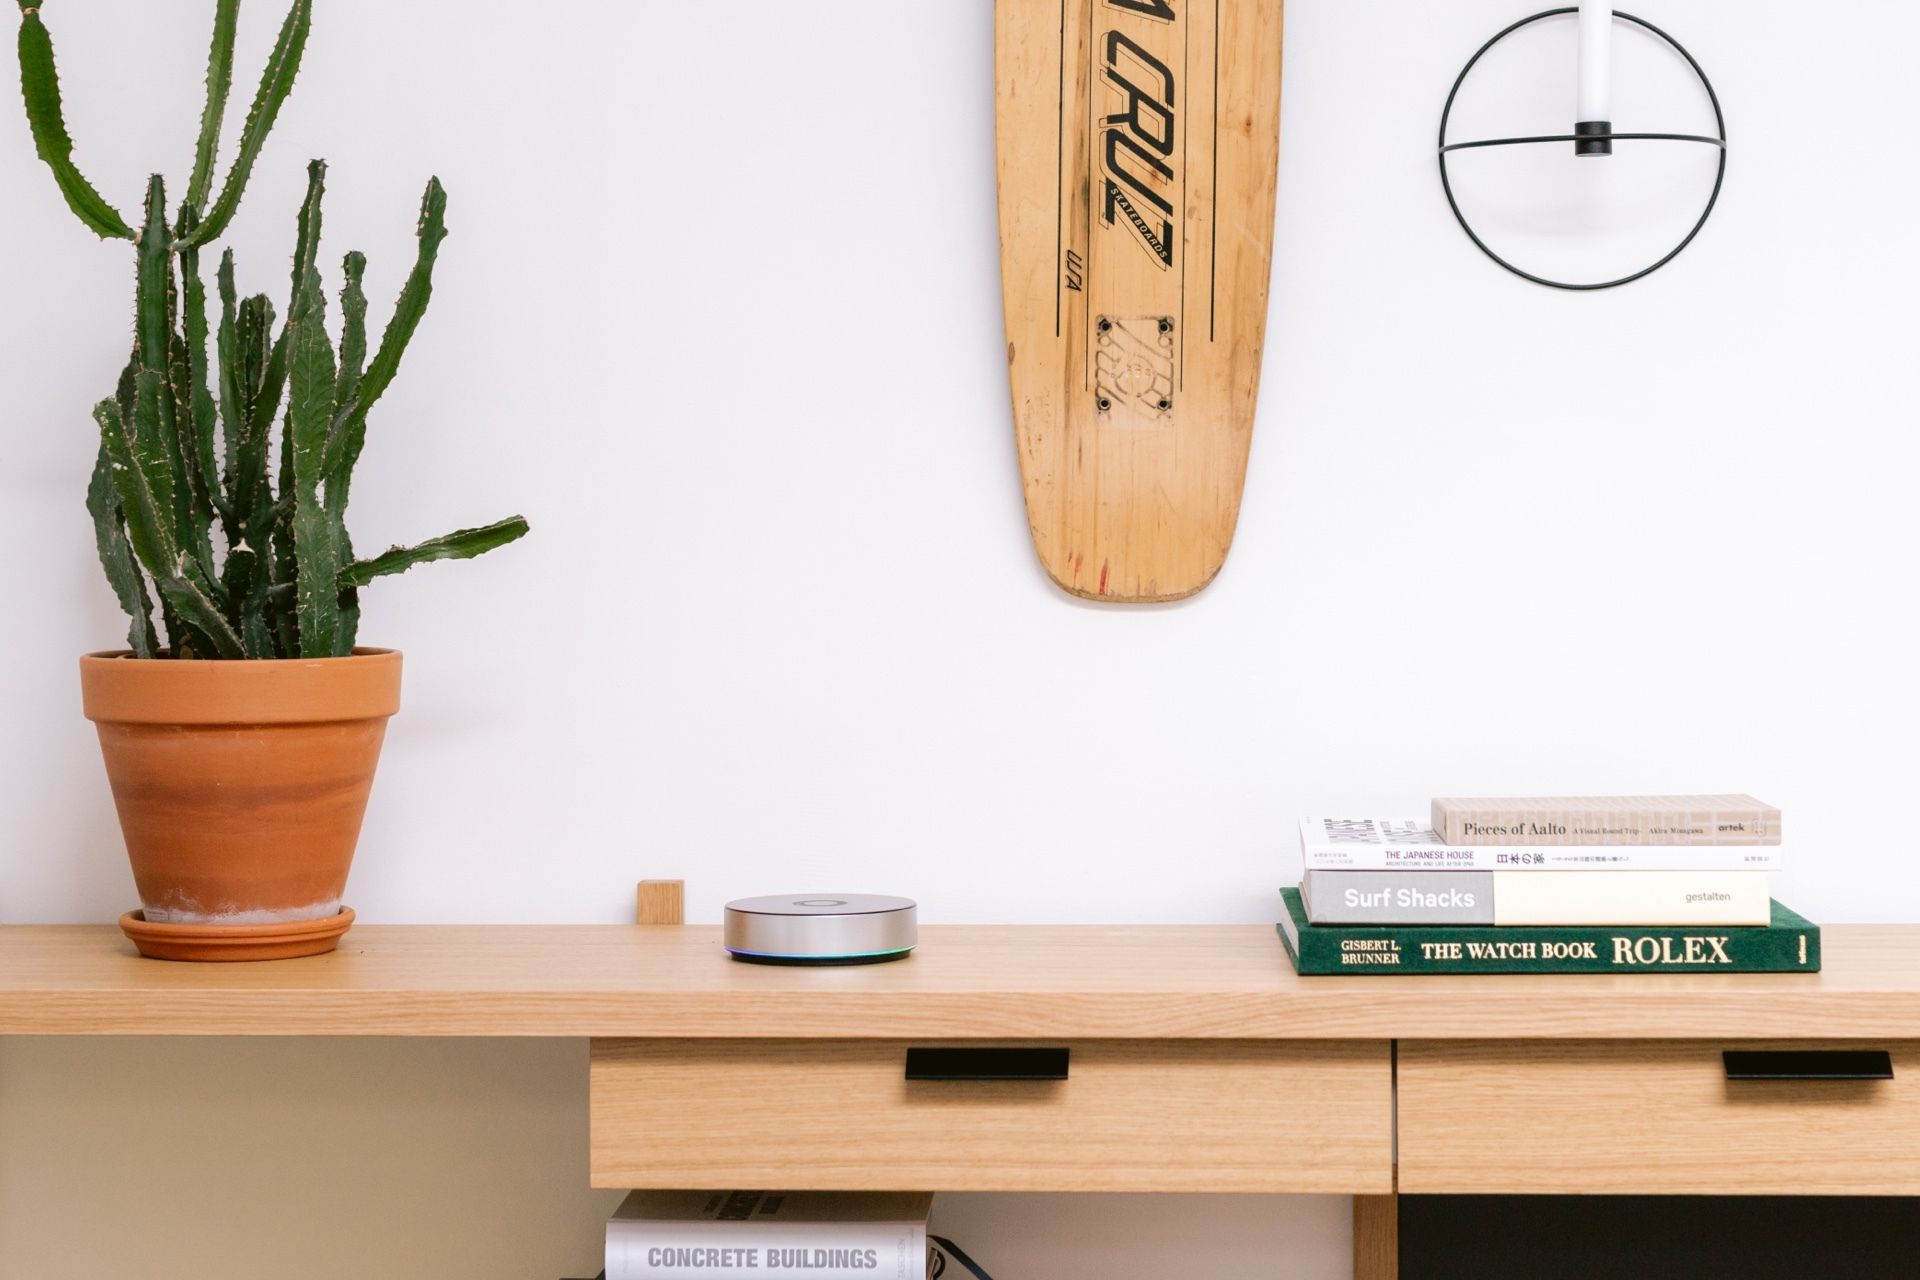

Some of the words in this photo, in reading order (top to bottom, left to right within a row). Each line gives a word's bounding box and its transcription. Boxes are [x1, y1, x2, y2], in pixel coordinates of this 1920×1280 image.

[1100, 30, 1175, 271] CRUZ
[1110, 187, 1168, 260] SKATEBOARDS
[1065, 249, 1083, 292] USA
[1463, 822, 1507, 836] Pieces
[1511, 822, 1525, 836] of
[1528, 822, 1566, 835] Aalto
[1718, 823, 1745, 832] artek
[1385, 851, 1401, 859] THE
[1403, 851, 1445, 859] JAPANESE
[1447, 851, 1475, 859] HOUSE
[1344, 888, 1391, 908] Surf
[1397, 888, 1476, 908] Shacks
[1685, 892, 1731, 903] gestalten
[1341, 940, 1390, 951] GISBERT
[1391, 940, 1402, 951] L.
[1421, 943, 1462, 960] THE
[1466, 943, 1536, 960] WATCH
[1541, 942, 1598, 959] BOOK
[1611, 937, 1733, 965] ROLEX
[1341, 953, 1400, 964] BRUNNER
[647, 1247, 759, 1269] CONCRETE
[766, 1247, 878, 1269] BUILDINGS
